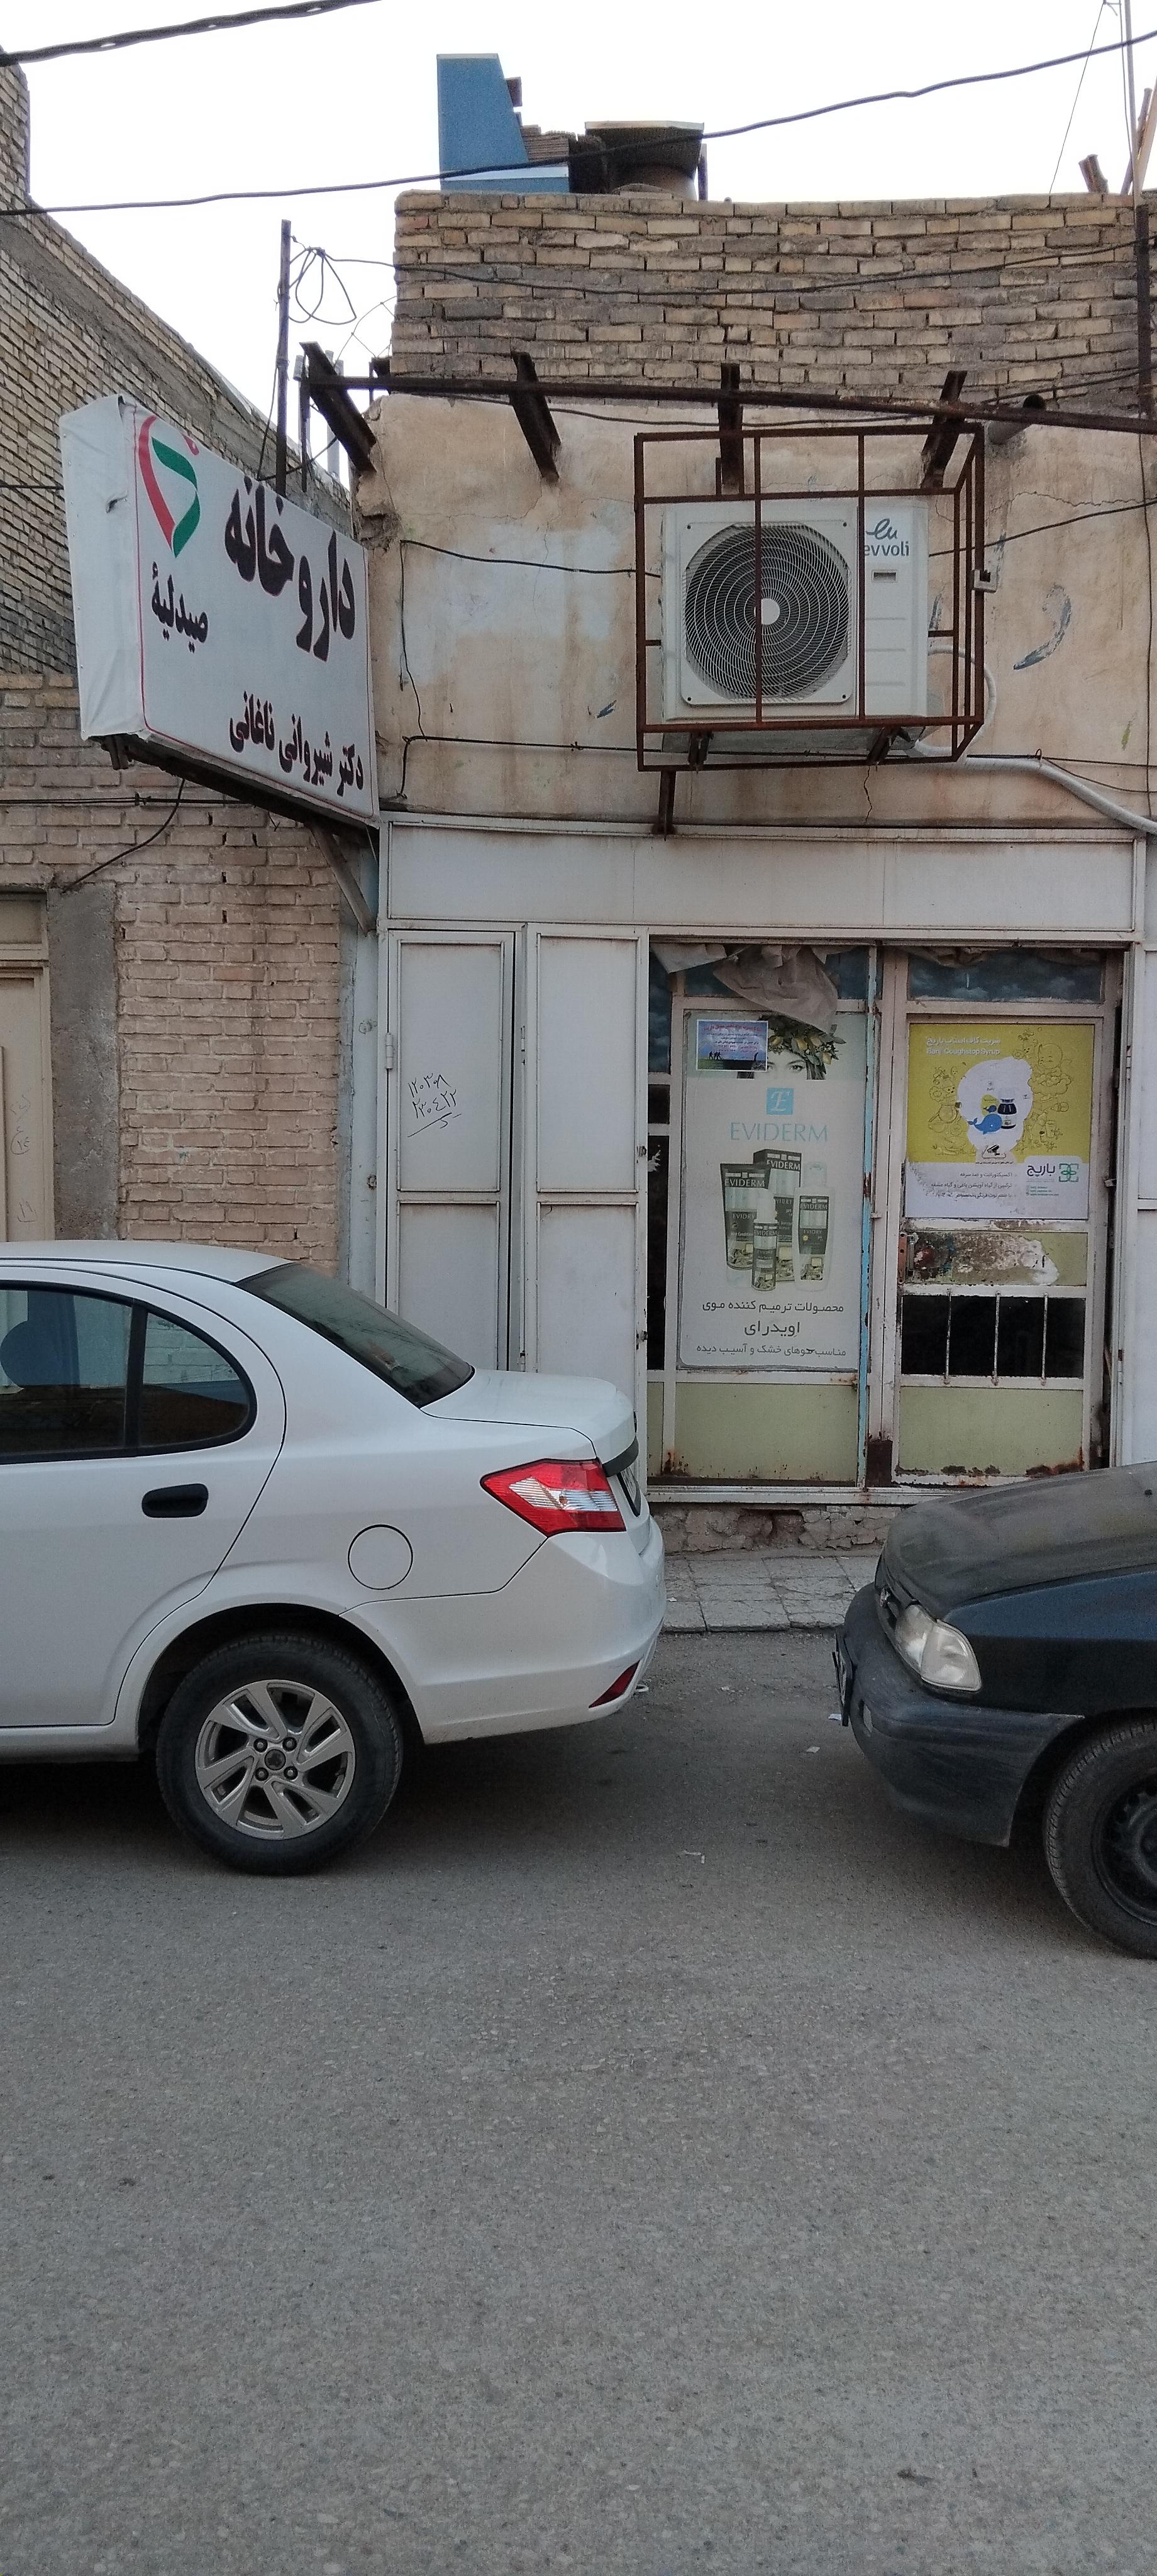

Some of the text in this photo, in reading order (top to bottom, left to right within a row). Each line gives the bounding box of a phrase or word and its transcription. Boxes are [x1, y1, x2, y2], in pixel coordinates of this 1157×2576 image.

[865, 541, 909, 556] evvoli
[230, 691, 364, 797] دکتر شیروانی ناغانی
[731, 1122, 828, 1142] EVIDERM
[767, 1160, 800, 1170] EVIDERM
[1027, 1163, 1055, 1177] باریج
[724, 1179, 765, 1187] EVIDERM
[702, 1301, 844, 1314] محصولات ترمیم کننده موی
[719, 1343, 748, 1355] آسیب
[757, 1345, 781, 1353] خشک
[815, 1348, 846, 1357] مناسب
